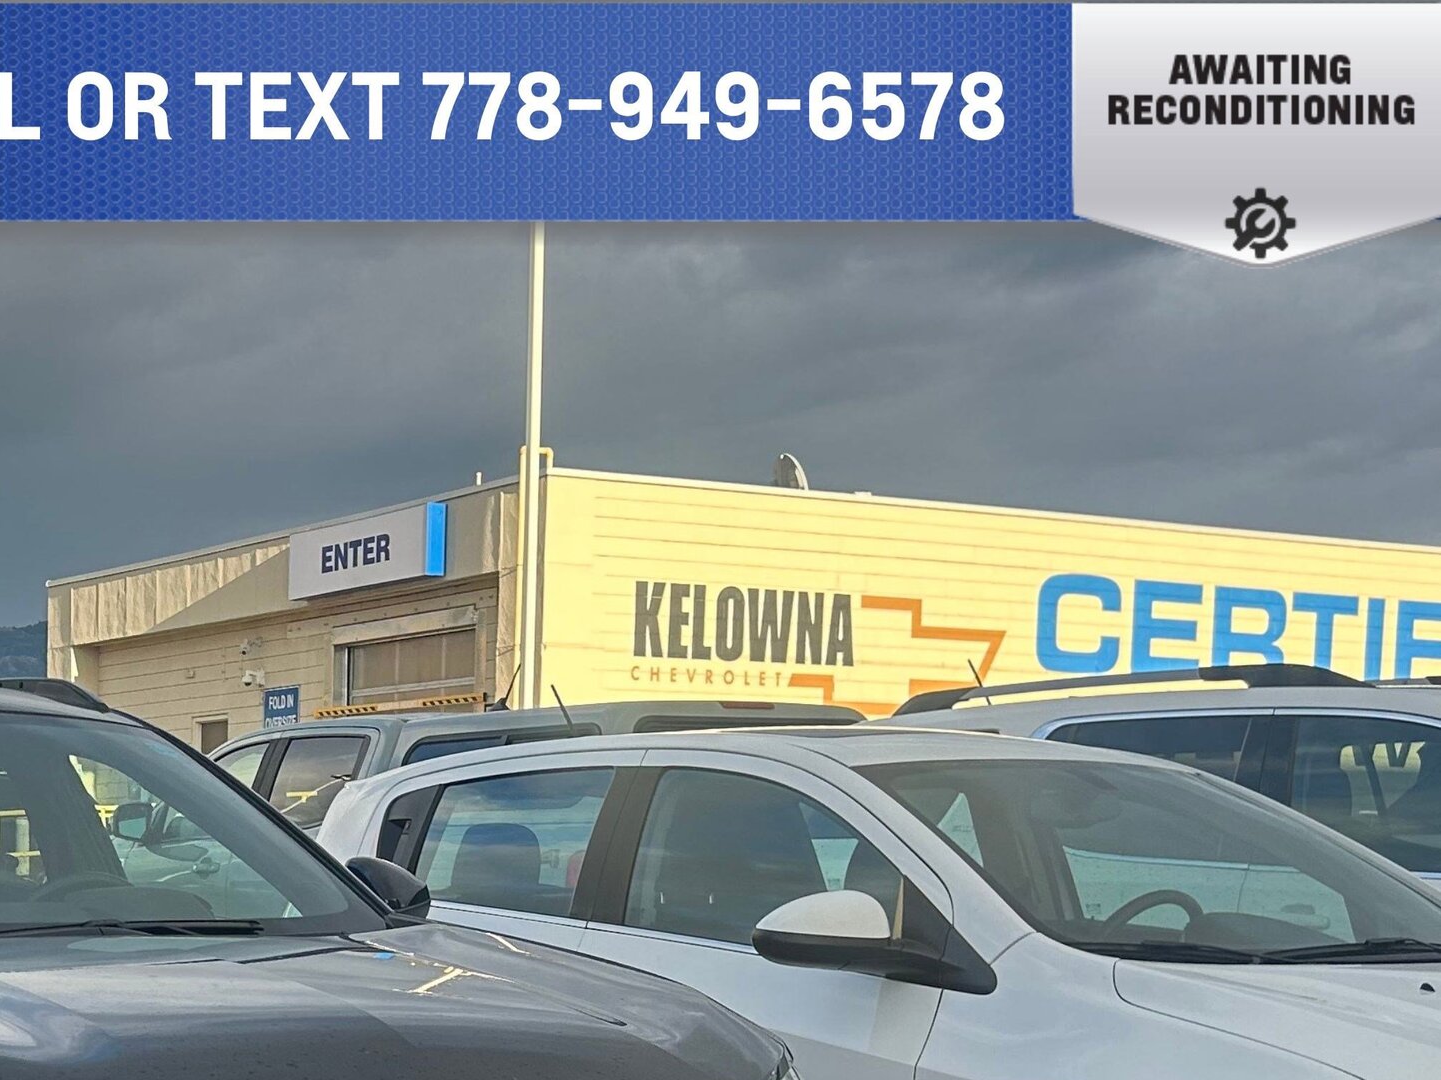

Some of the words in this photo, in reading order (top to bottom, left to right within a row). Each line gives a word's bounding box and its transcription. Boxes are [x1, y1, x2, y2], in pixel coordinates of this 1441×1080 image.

[321, 533, 390, 574] ENTER
[633, 580, 854, 667] KELOWNA
[630, 665, 783, 688] CHEVROLET
[268, 694, 287, 710] FOLD
[286, 693, 295, 709] IN
